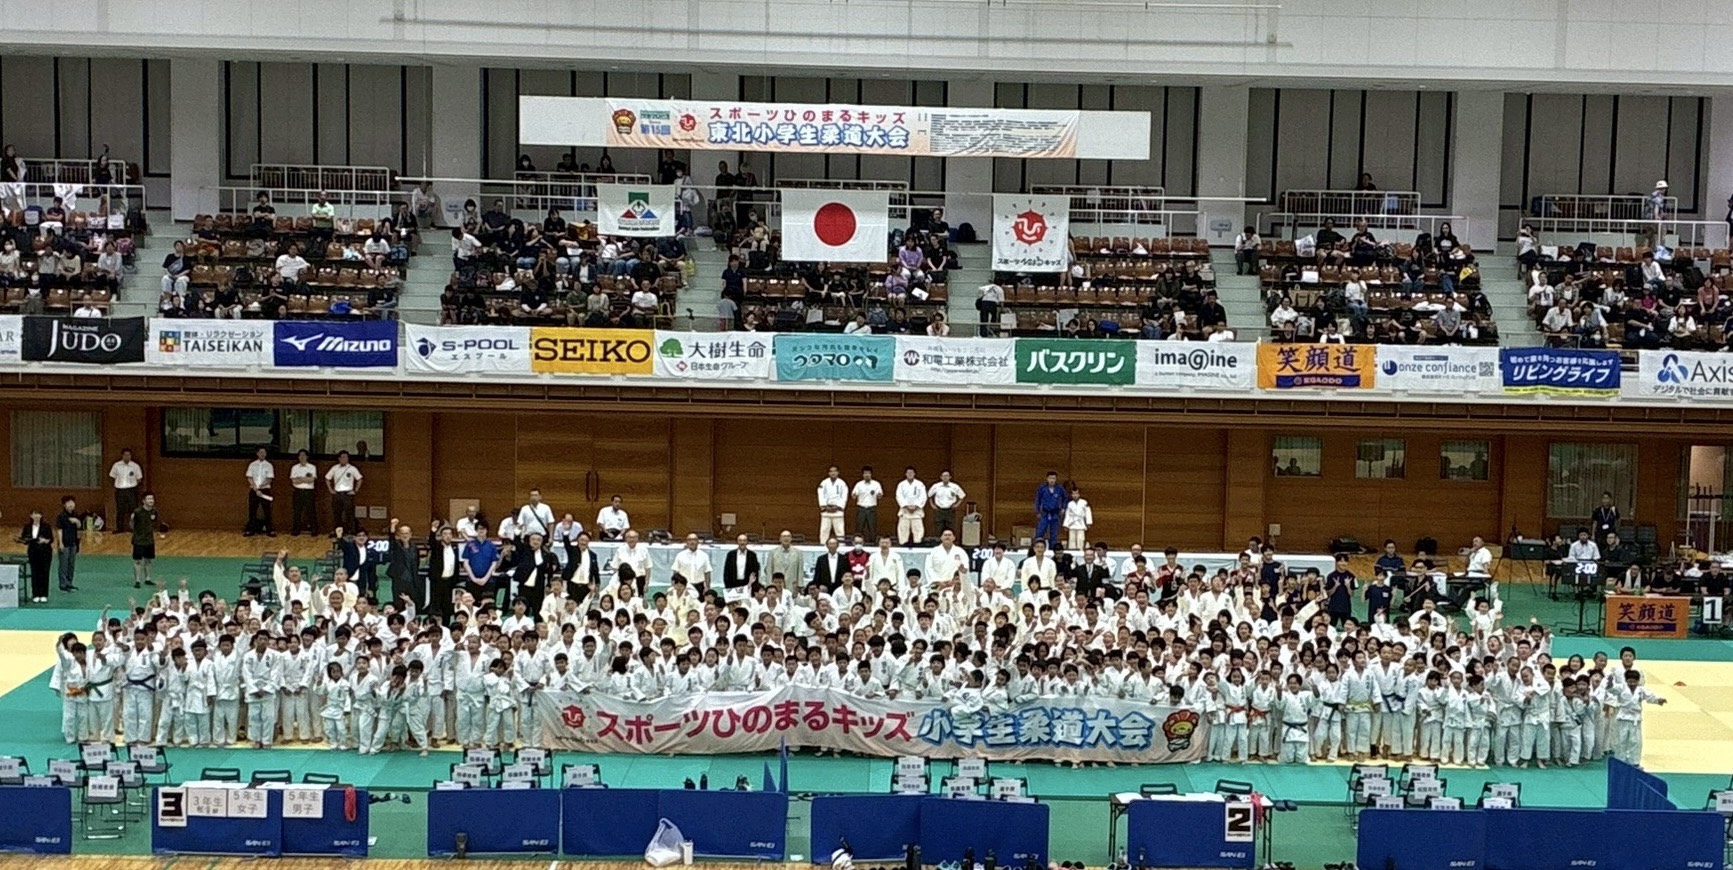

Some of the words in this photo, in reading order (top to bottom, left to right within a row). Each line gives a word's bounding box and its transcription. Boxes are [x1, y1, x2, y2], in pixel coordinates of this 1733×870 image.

[710, 107, 906, 124] スポーツひのまるキッズ
[641, 124, 671, 135] 第15回
[708, 121, 910, 148] 東北小学生柔道大会
[47, 319, 121, 358] JUDO
[316, 336, 391, 352] MIZUNO
[442, 339, 520, 351] S-POOL
[451, 352, 507, 360] エスプール
[534, 338, 651, 363] SEIKO
[688, 341, 767, 358] 大樹生命
[690, 361, 749, 371] 日本生命グループ
[922, 354, 1009, 367] 和電工業株式会社
[1026, 349, 1125, 374] バスクリン
[1277, 345, 1361, 373] 笑顔道
[1398, 362, 1423, 372] onze
[1425, 361, 1477, 374] confiance
[1513, 364, 1611, 383] リビングライフ
[1690, 360, 1733, 382] Axis
[1575, 562, 1598, 574] 2:00
[1617, 603, 1677, 621] 笑顔道
[1704, 599, 1722, 622] 1
[597, 700, 915, 745] スポーツひのまるキッズ
[919, 706, 1155, 749] 小学生柔道大会
[193, 796, 223, 807] 3年生
[233, 790, 263, 801] 5年生
[288, 791, 320, 801] 5年生
[161, 792, 183, 817] 3
[238, 804, 258, 815] 女子
[293, 803, 314, 815] 男子
[1227, 807, 1251, 832] 2
